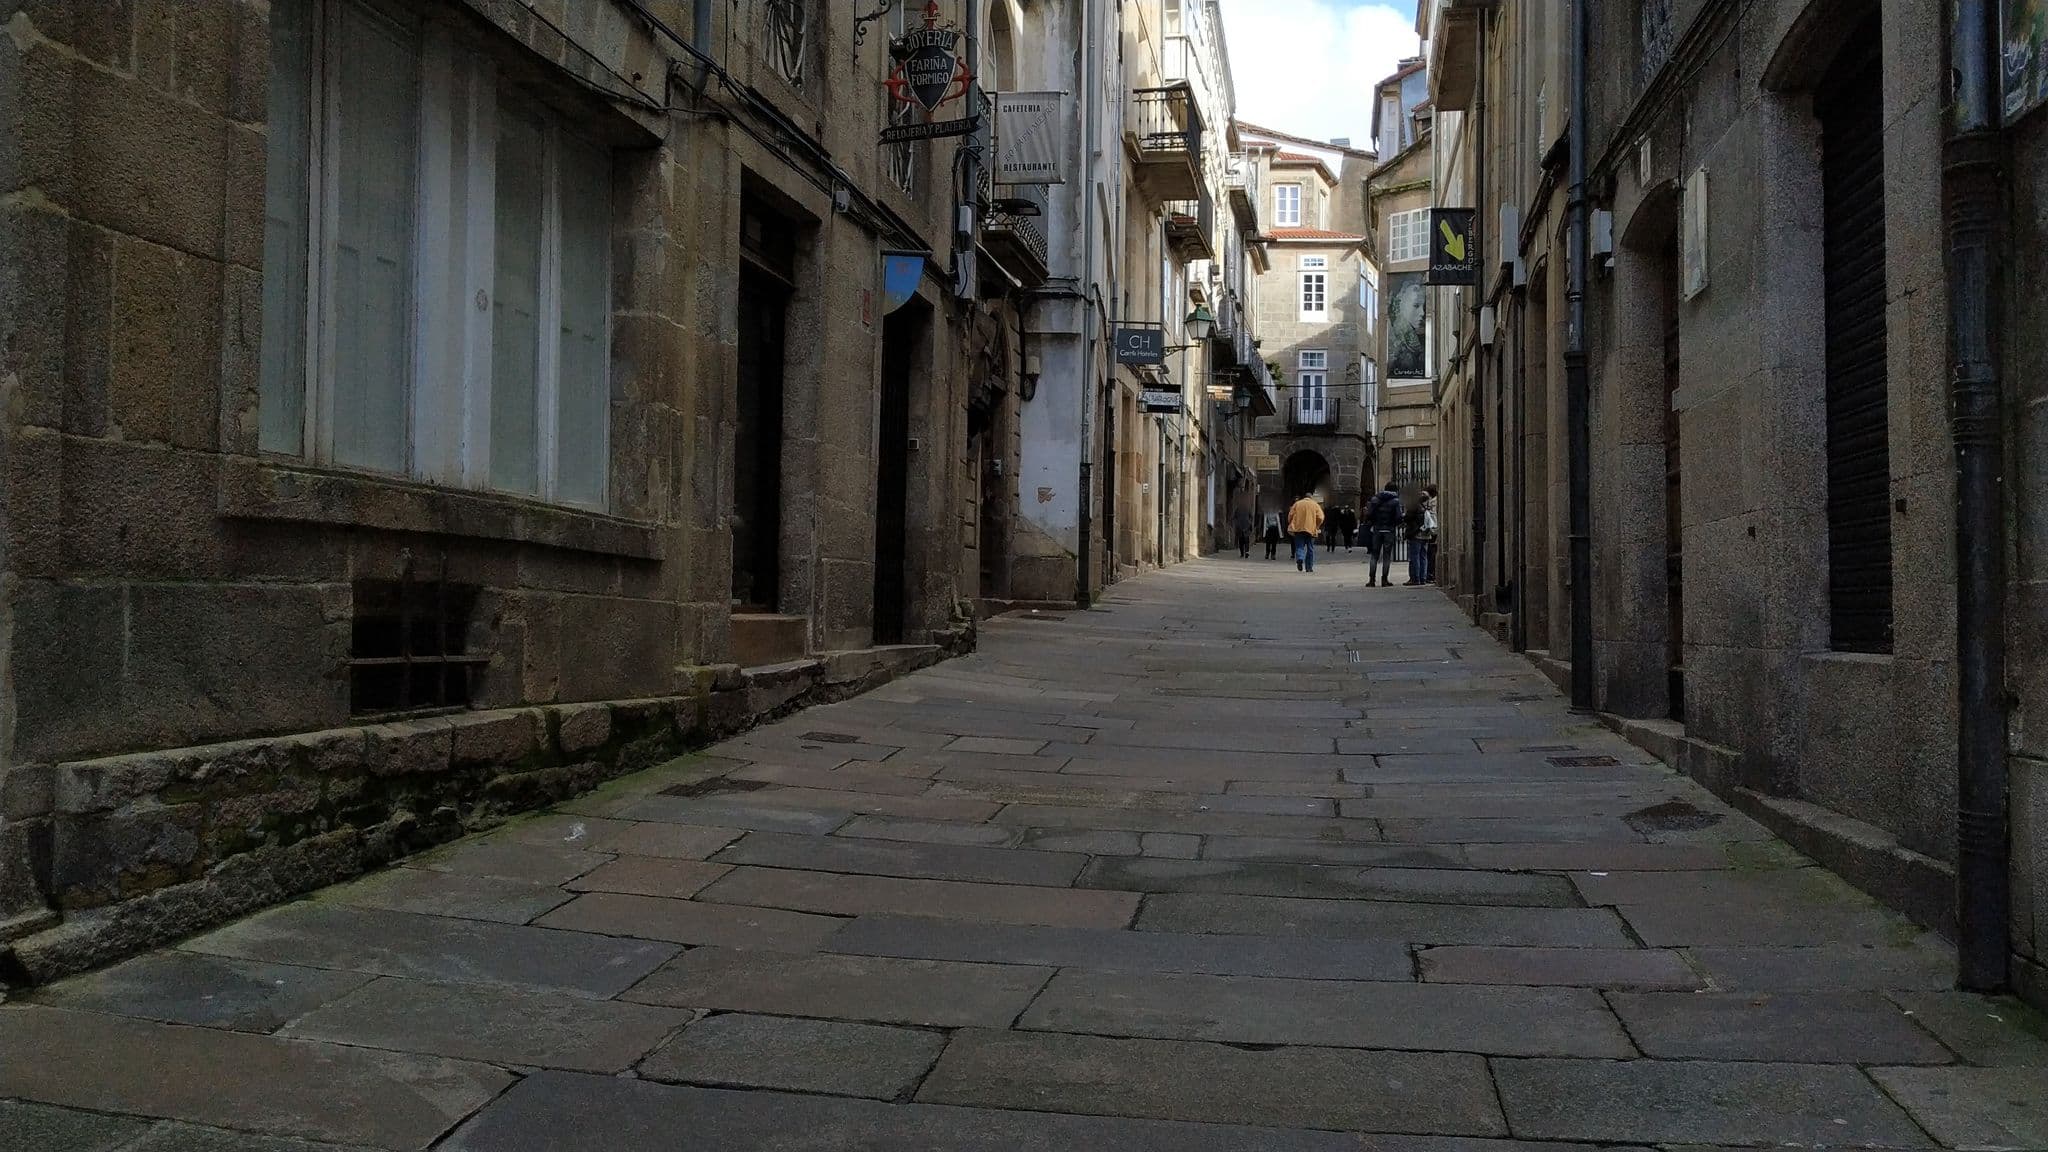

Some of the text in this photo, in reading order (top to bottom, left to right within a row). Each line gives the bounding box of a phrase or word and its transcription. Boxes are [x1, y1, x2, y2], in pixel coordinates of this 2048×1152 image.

[911, 55, 948, 72] FARIÑA
[911, 72, 950, 87] FORMIGO
[1003, 104, 1041, 113] CAFETERIA
[926, 124, 933, 135] Y
[1003, 162, 1057, 172] RESTAURANTE
[1129, 334, 1150, 349] CH
